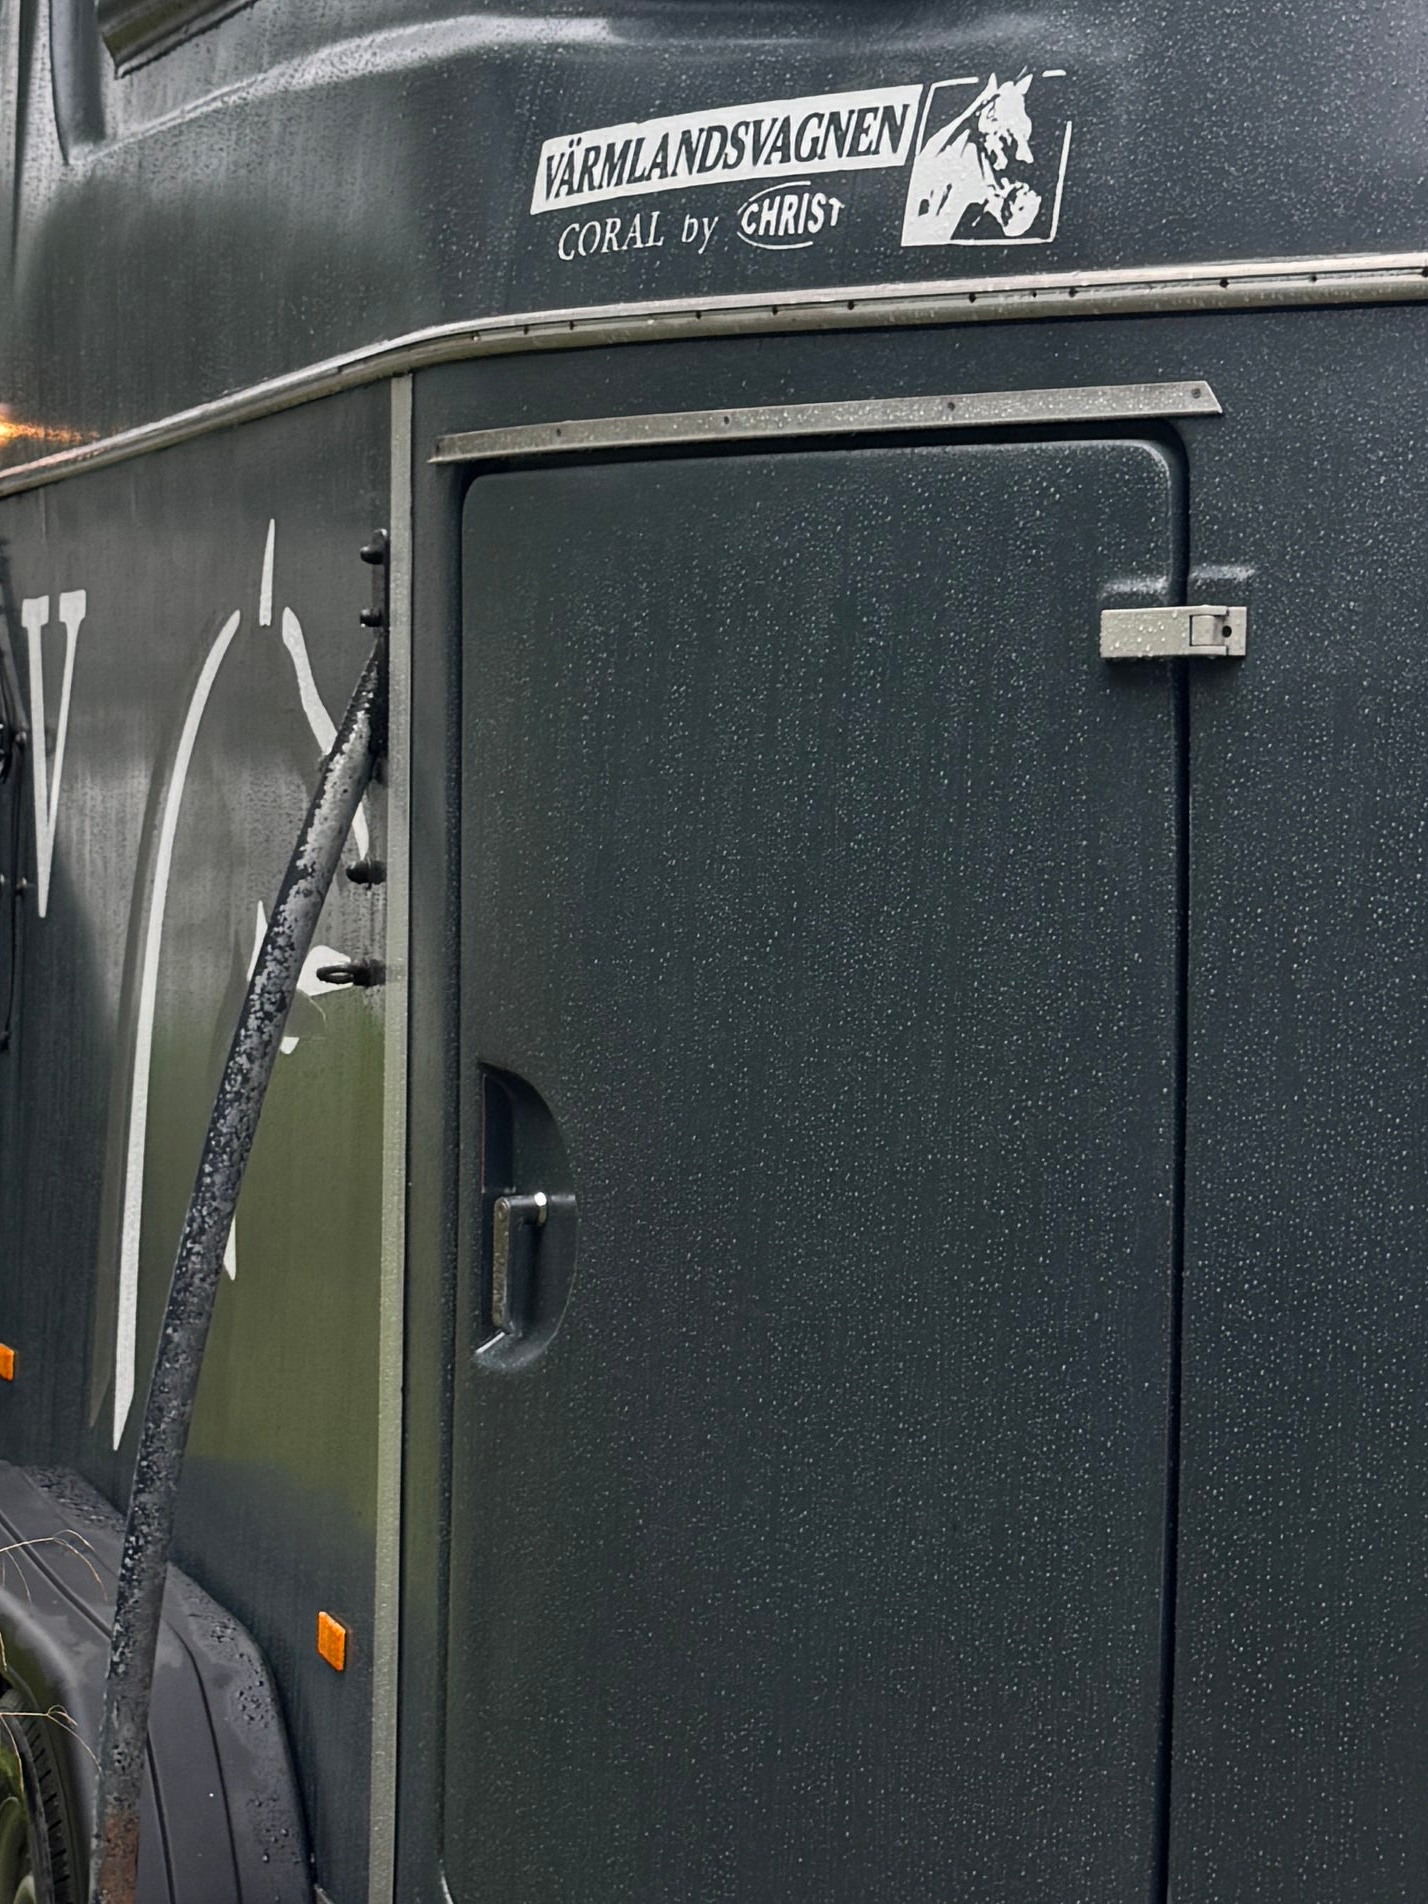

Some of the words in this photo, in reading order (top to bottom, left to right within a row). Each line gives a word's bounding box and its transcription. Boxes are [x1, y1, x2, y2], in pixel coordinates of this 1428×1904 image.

[544, 104, 911, 201] VÄRMLANDSVAGNEN
[557, 210, 665, 262] CORAL
[680, 213, 720, 255] by
[738, 192, 846, 239] CHRIST
